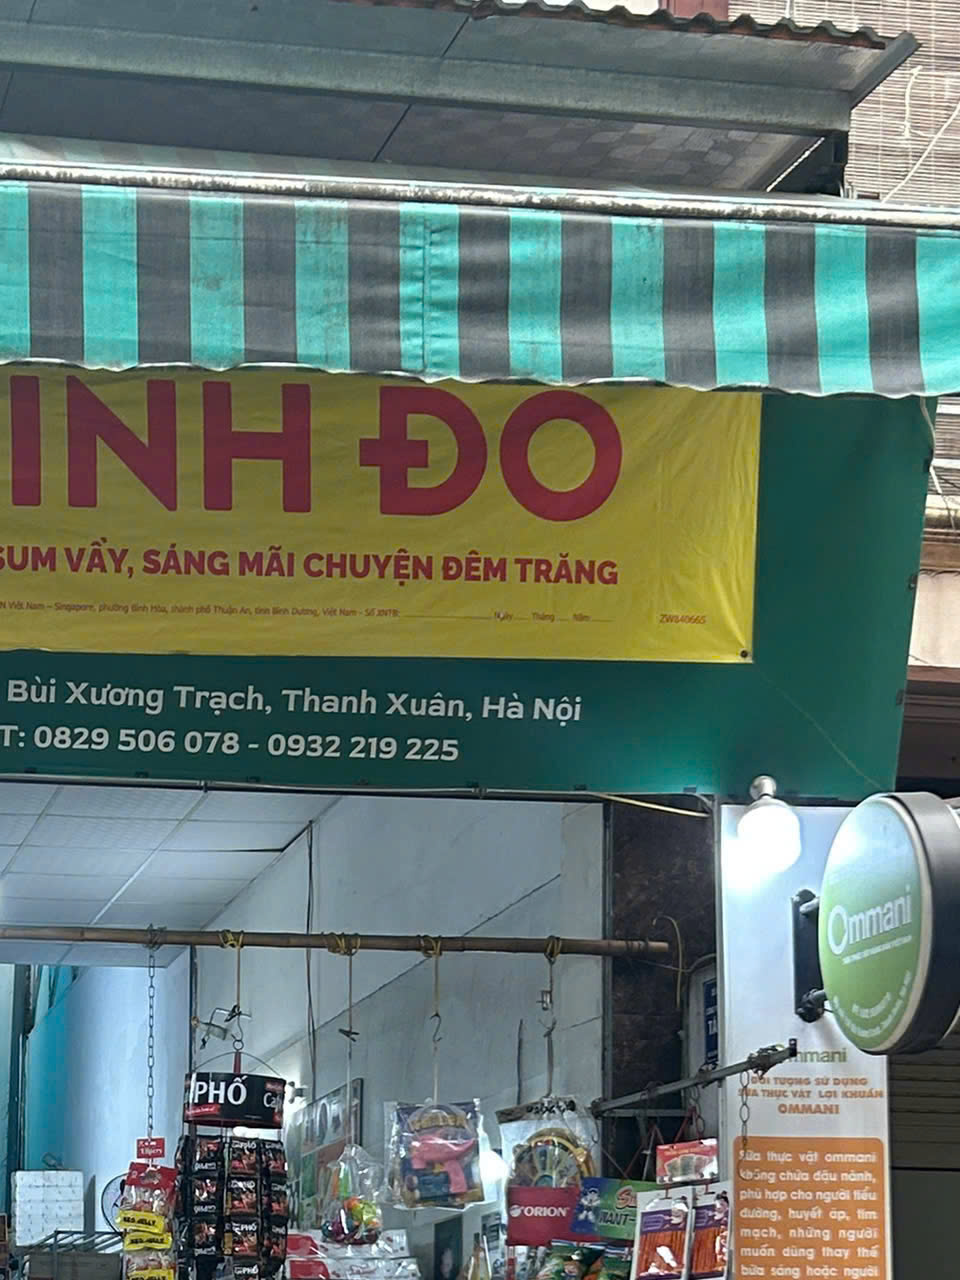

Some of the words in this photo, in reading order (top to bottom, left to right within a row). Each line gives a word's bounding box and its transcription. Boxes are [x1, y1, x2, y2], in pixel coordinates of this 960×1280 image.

[142, 545, 230, 578] SÁNG
[238, 545, 295, 578] MÃI
[303, 548, 434, 587] CHUYỆN
[441, 549, 508, 583] ĐÊM
[515, 550, 619, 586] TRĂNG
[8, 677, 58, 706] Bùi
[65, 681, 163, 716] Xương
[174, 684, 272, 718] Trạch,
[282, 687, 378, 716] Thanh
[385, 688, 473, 722] Xuân,
[480, 691, 524, 720] Hà
[532, 694, 582, 724] Nội
[33, 723, 110, 751] 0829
[118, 727, 176, 754] 506
[184, 729, 242, 756] 078
[268, 732, 342, 759] 0932
[348, 735, 400, 762] 219
[404, 736, 460, 763] 225
[828, 883, 913, 956] Ommani
[194, 1075, 248, 1106] PHỐ
[778, 1102, 840, 1114] OMMANI
[524, 1206, 568, 1218] ORION
